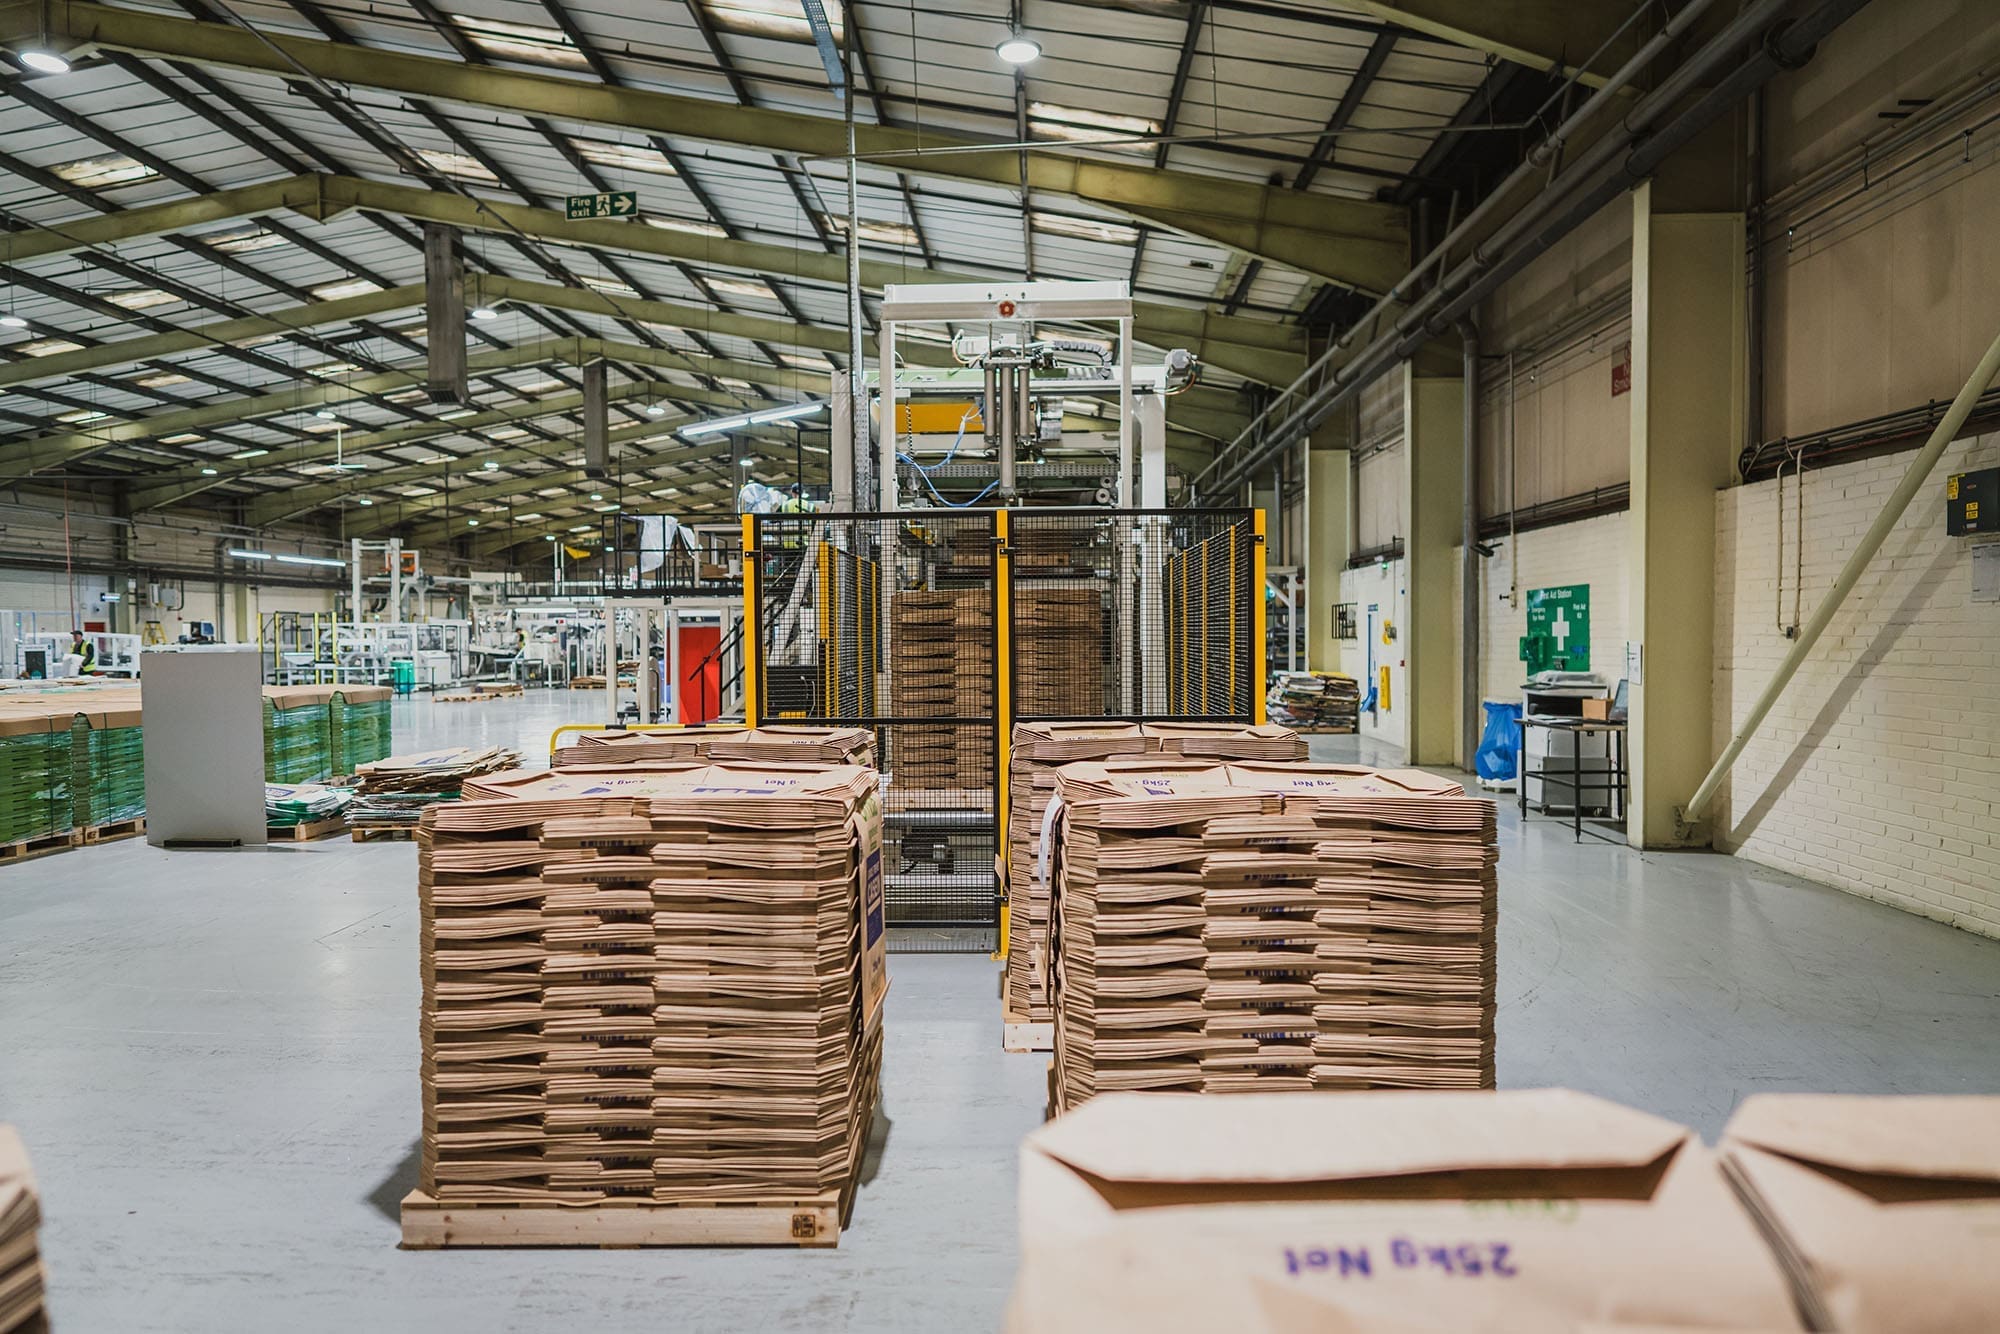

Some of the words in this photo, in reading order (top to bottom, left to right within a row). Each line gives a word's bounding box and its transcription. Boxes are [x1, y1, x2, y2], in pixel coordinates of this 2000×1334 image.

[571, 198, 591, 207] Fire
[571, 208, 590, 217] exit
[1558, 589, 1572, 599] Station
[1283, 1247, 1373, 1278] Net
[1390, 1237, 1519, 1278] 25kg
